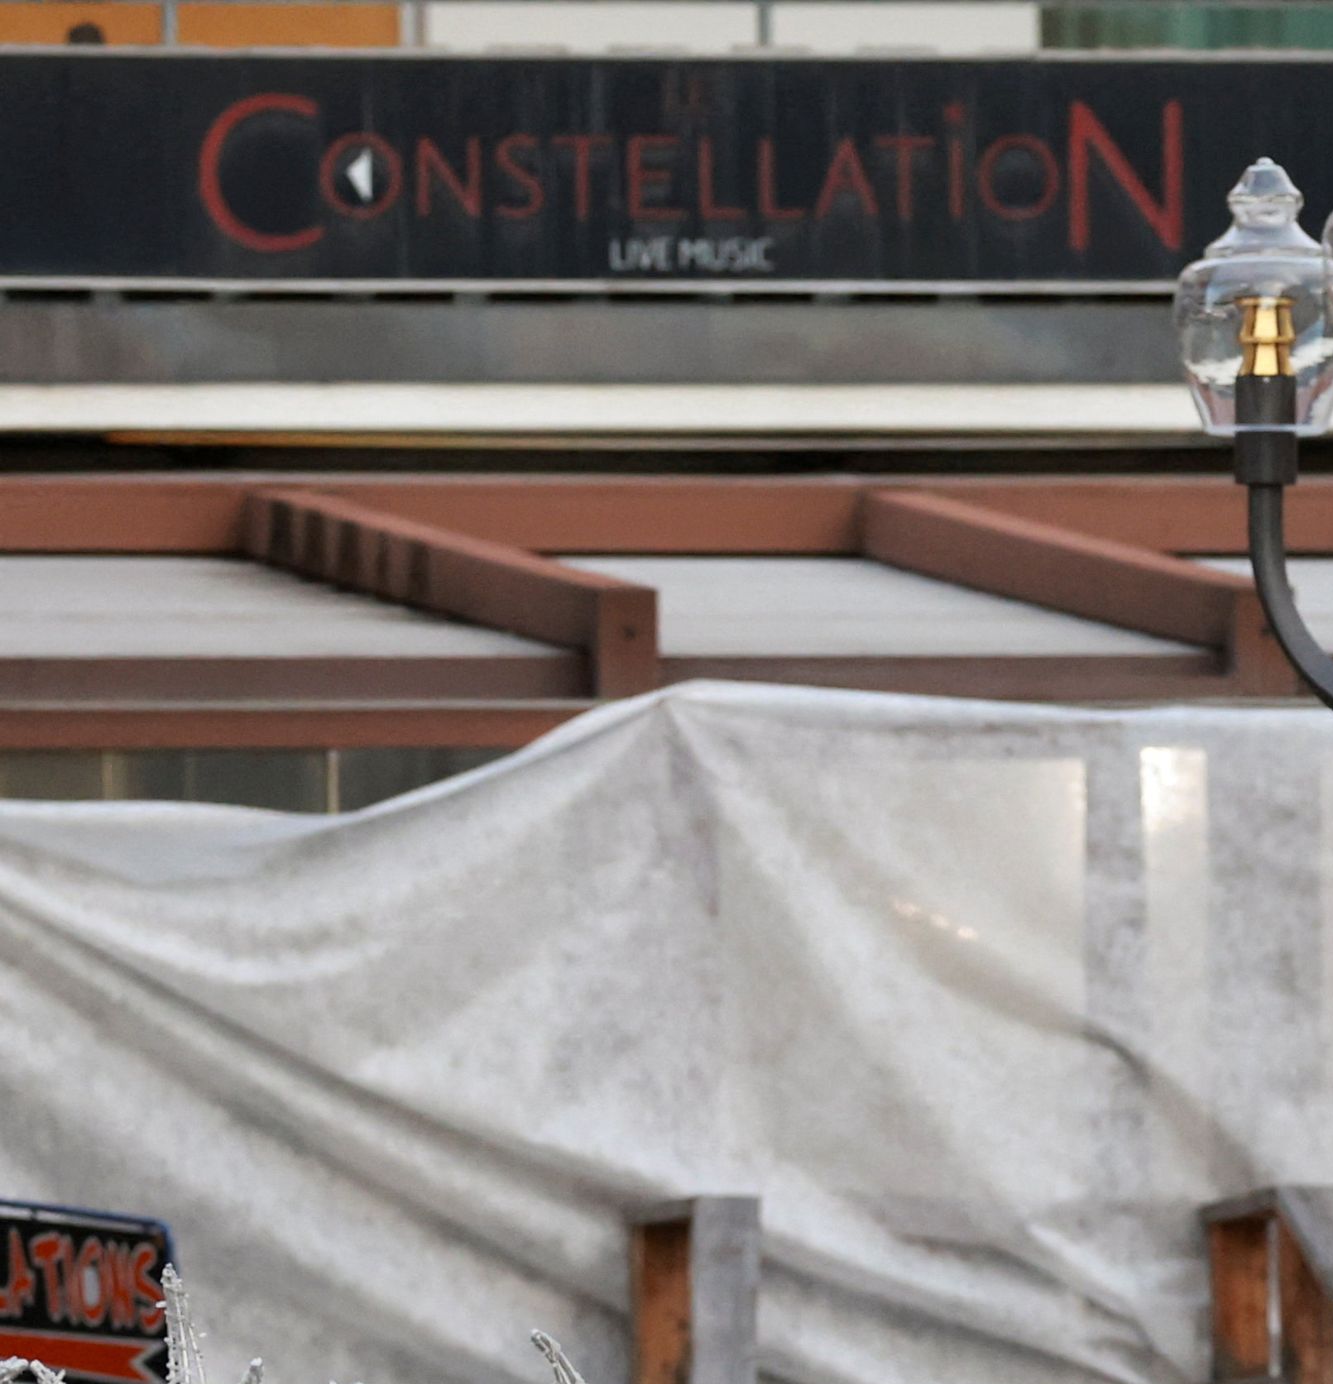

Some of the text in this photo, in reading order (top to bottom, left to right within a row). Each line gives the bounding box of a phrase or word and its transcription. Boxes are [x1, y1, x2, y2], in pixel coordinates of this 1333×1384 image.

[608, 236, 775, 271] LIVE MUSIC
[0, 1226, 165, 1335] ATIONS
